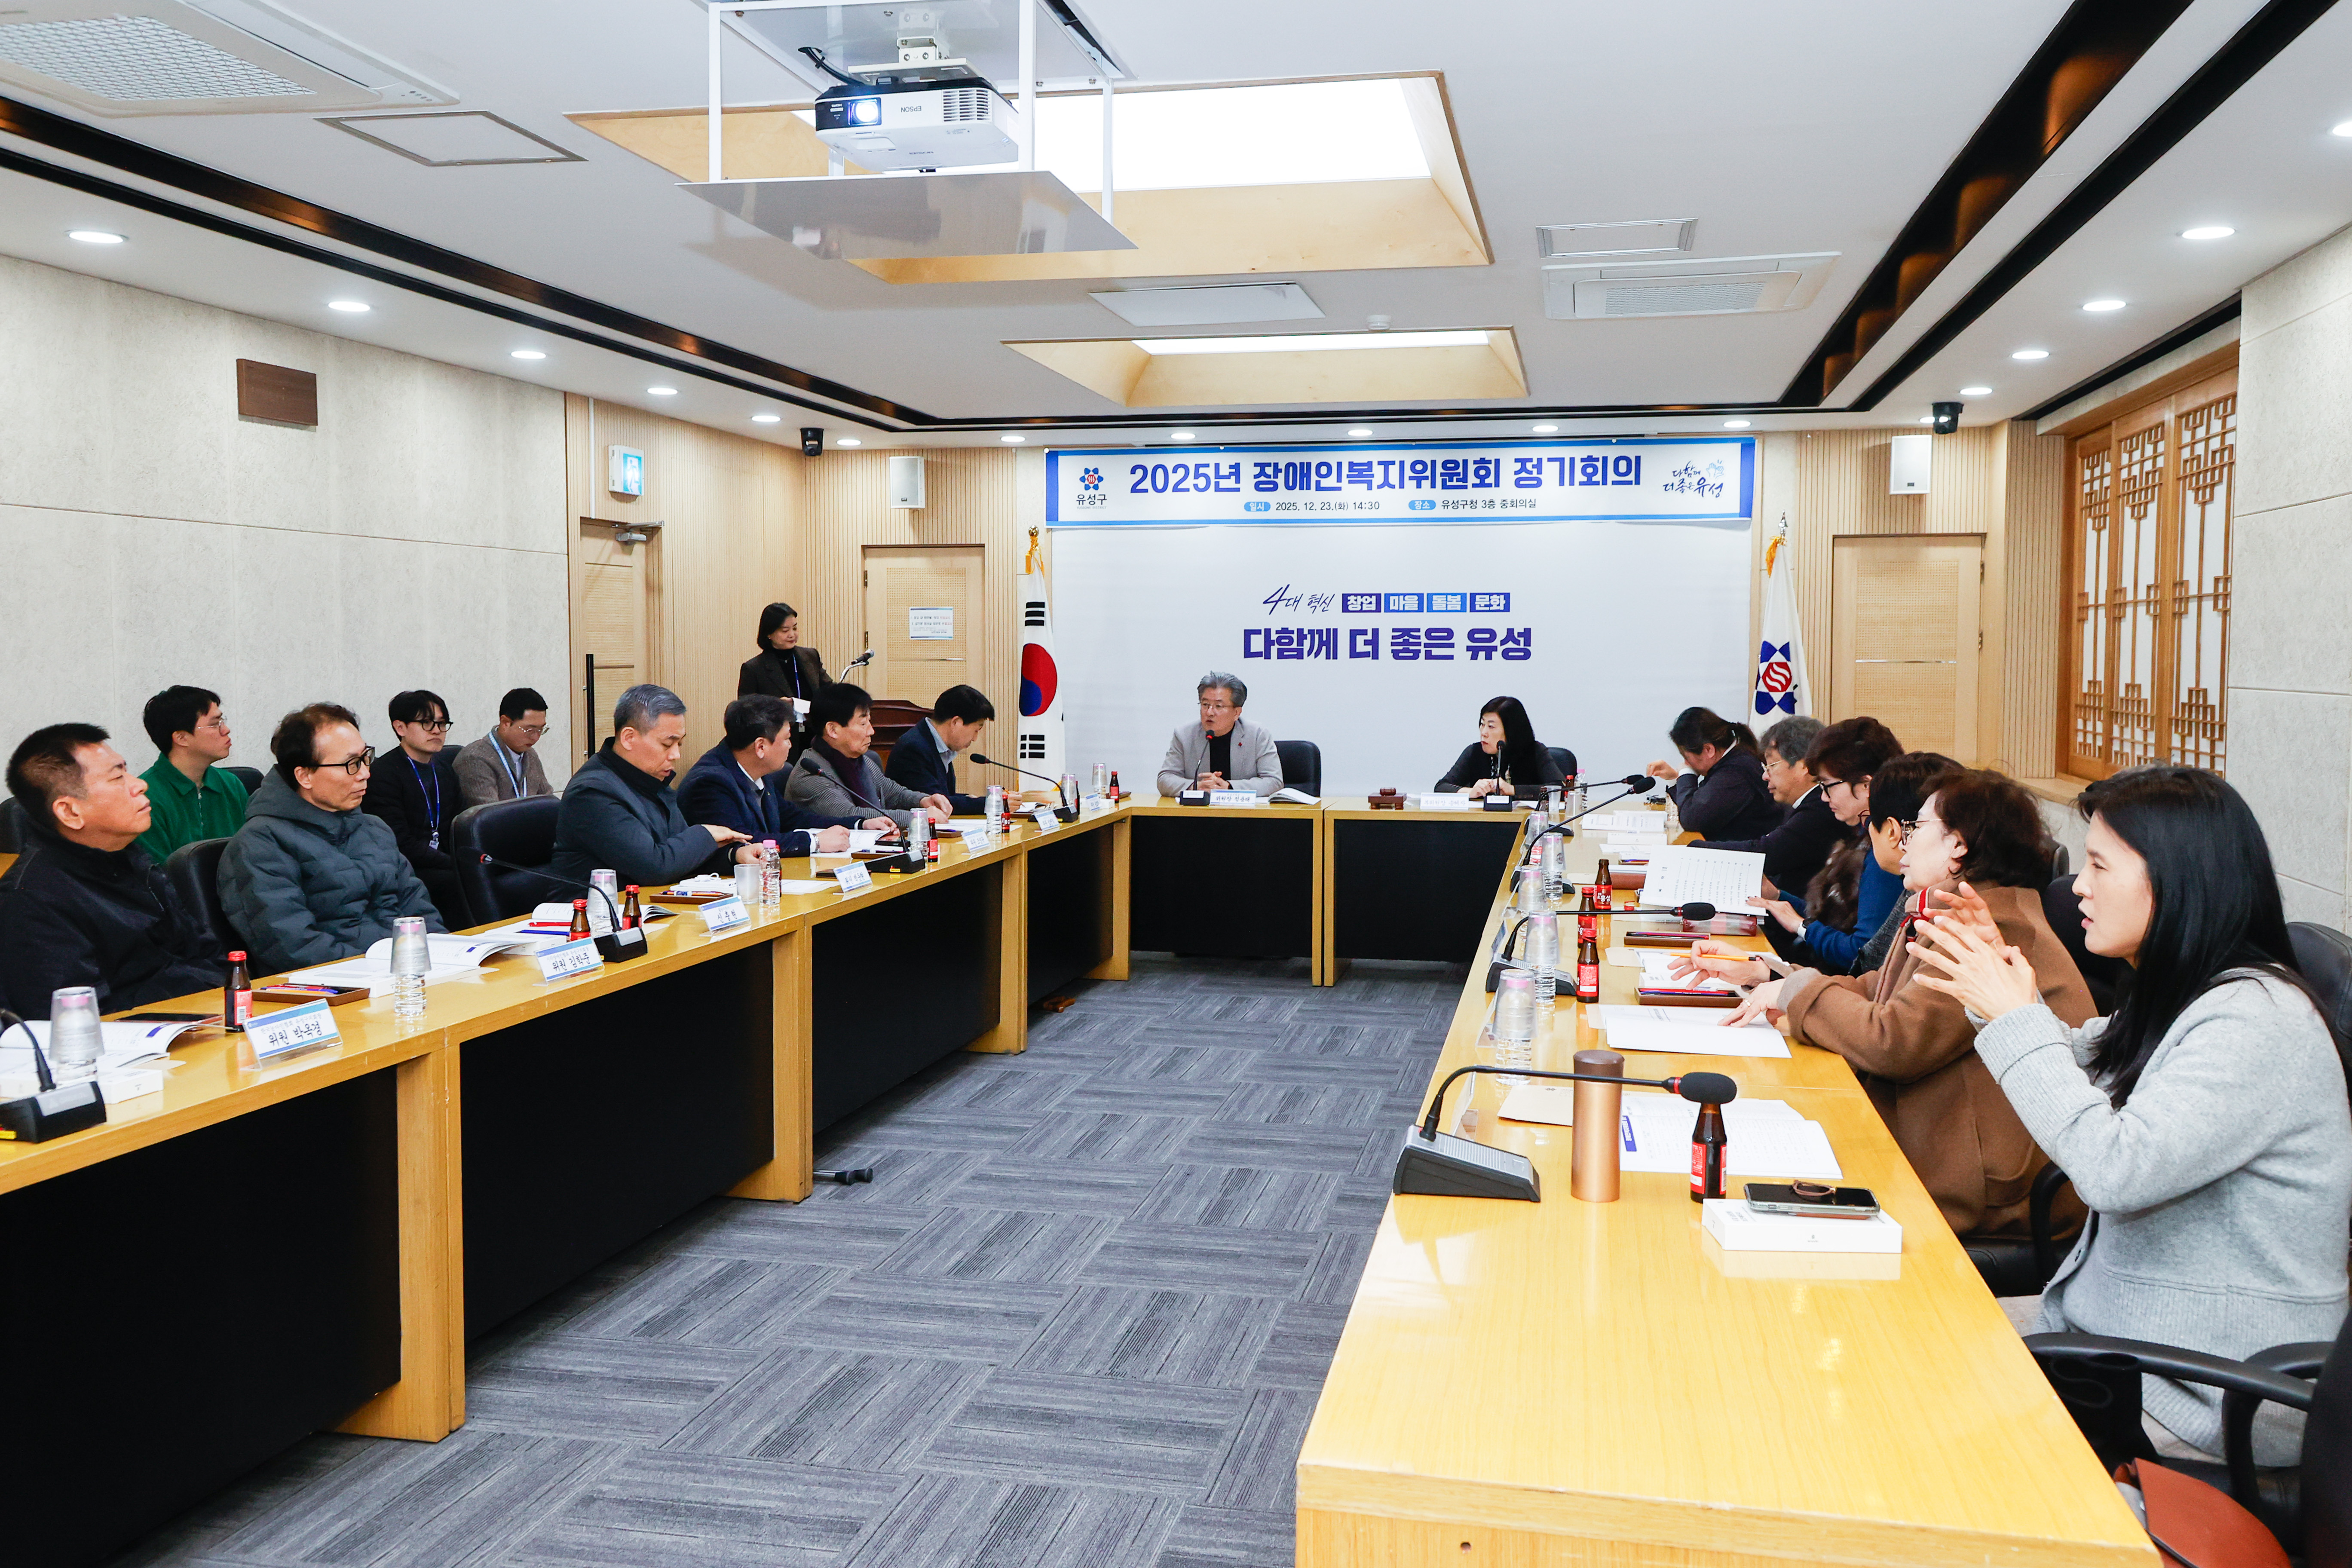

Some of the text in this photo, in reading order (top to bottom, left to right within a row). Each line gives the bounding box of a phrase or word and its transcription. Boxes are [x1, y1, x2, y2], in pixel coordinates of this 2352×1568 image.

[1130, 455, 1641, 493] 2025년 장애인복지위원회 정기회의
[1672, 460, 1701, 478] 다함께
[1663, 477, 1723, 498] 더 좋은 유성
[1076, 494, 1107, 505] 유성구
[1249, 502, 1265, 511] 일시
[1276, 502, 1300, 511] 2025.
[1304, 502, 1317, 511] 12.
[1353, 501, 1380, 510] 14:30
[1414, 499, 1537, 510] 장소 유성구청 3층 중회의실
[1262, 584, 1506, 615] 4대 혁신 창업 마을 돌봄 문화
[1243, 628, 1531, 661] 다함께 더 좋은 유성
[552, 952, 591, 972] 위원 김학준
[269, 1021, 322, 1047] 위원 박옥경
